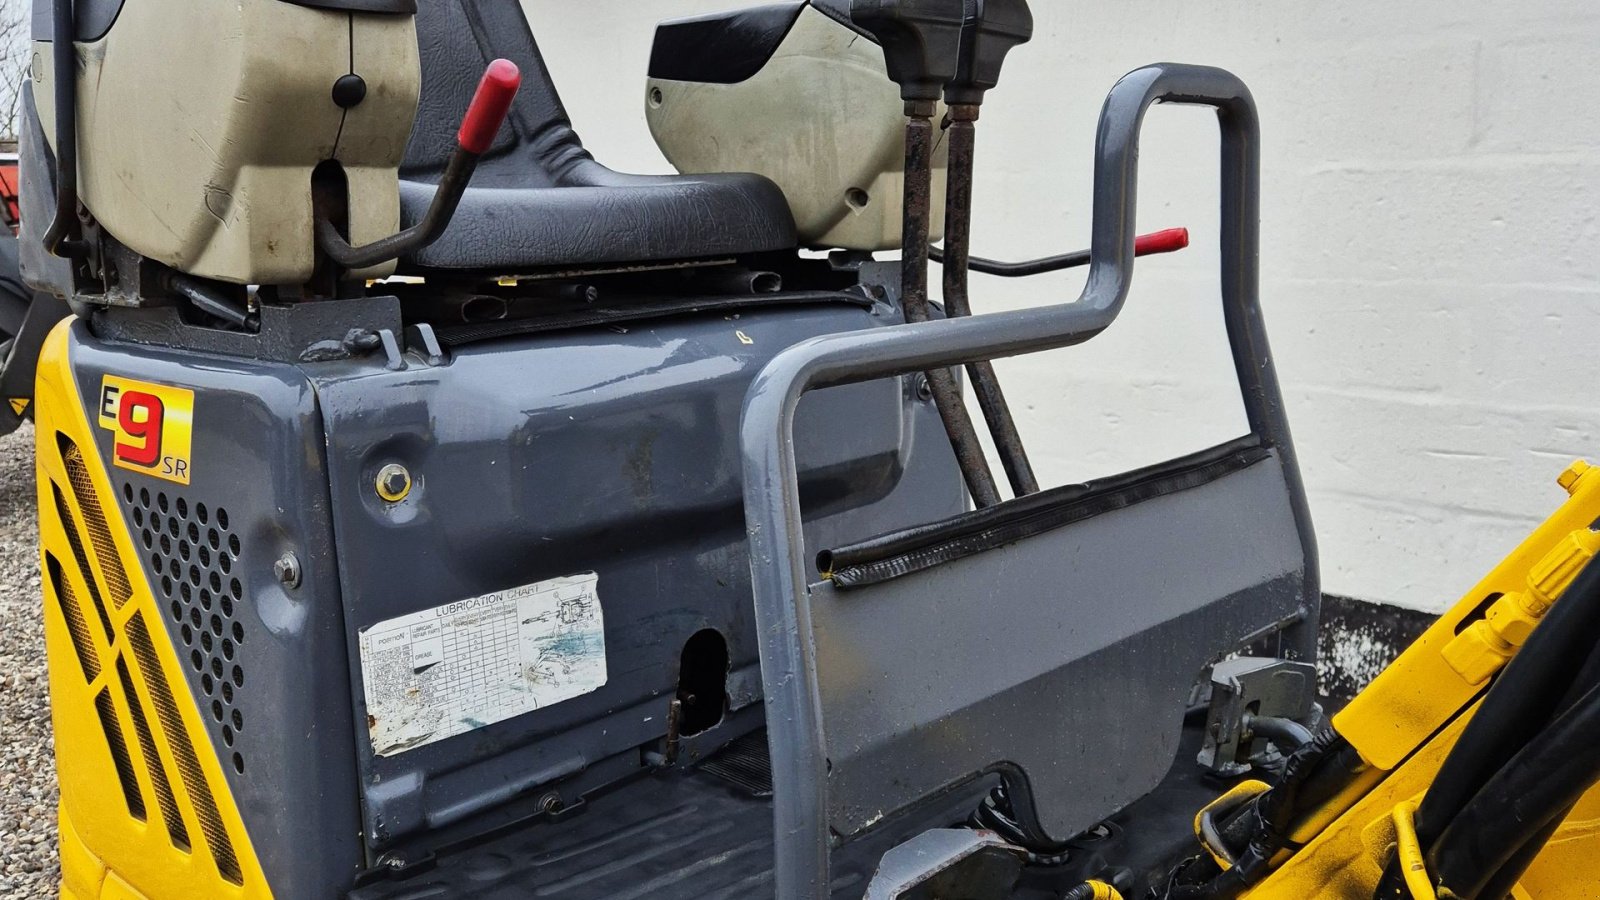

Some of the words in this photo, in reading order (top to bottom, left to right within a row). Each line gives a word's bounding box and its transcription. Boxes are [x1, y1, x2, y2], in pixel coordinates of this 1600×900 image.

[162, 456, 187, 478] SR
[436, 594, 503, 617] LUBRICATION
[507, 584, 539, 599] CHART
[415, 651, 432, 660] GREASE
